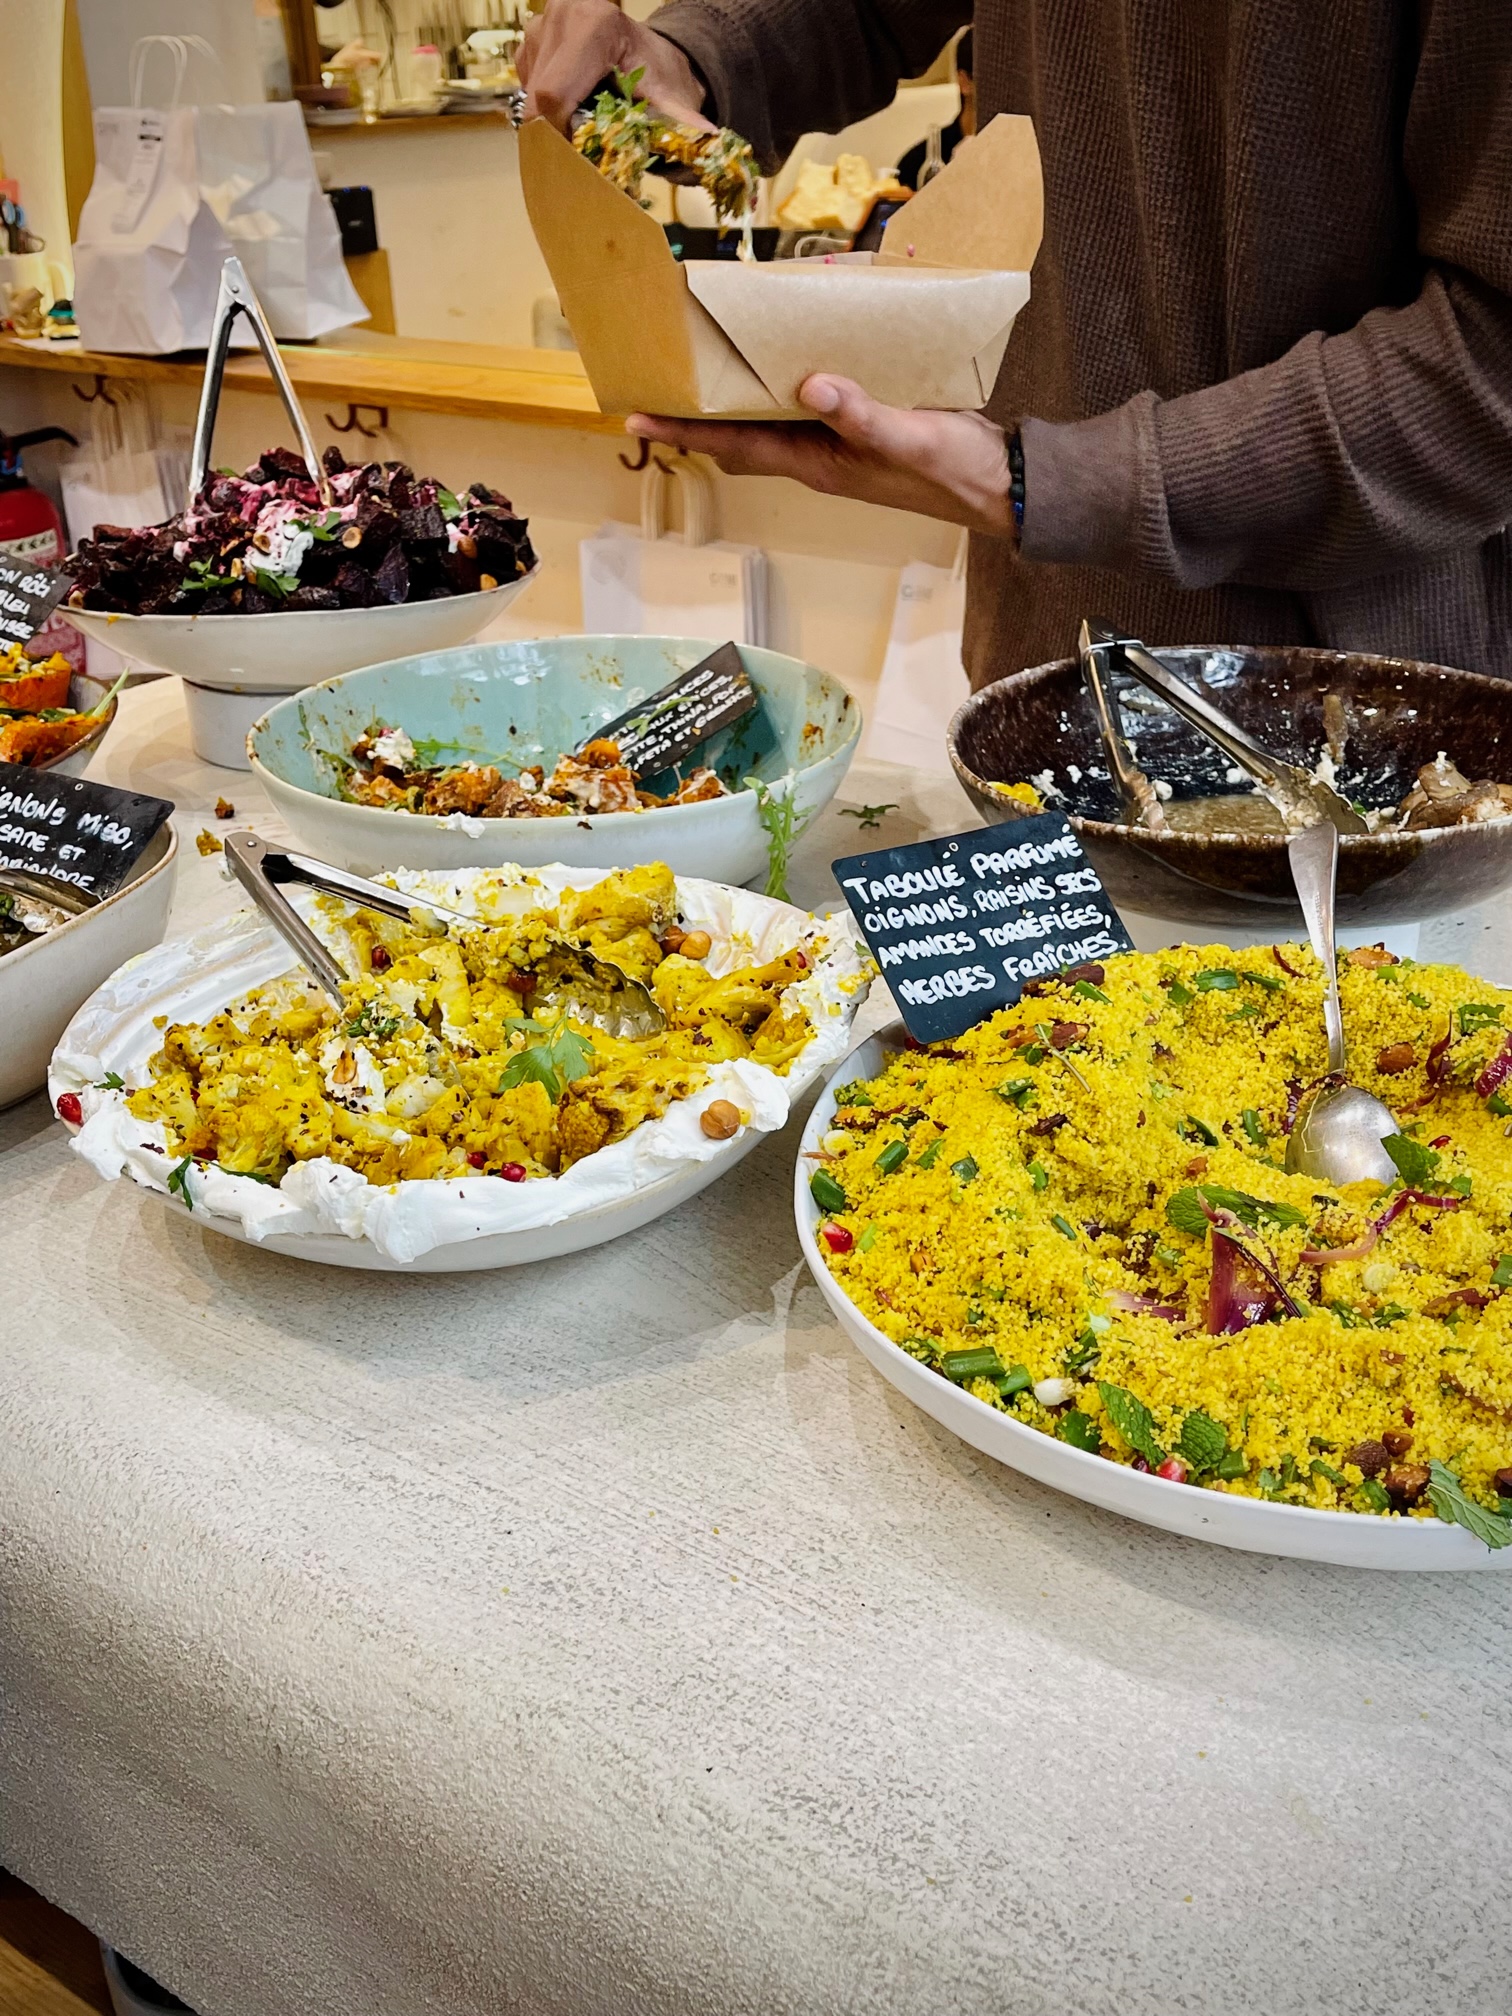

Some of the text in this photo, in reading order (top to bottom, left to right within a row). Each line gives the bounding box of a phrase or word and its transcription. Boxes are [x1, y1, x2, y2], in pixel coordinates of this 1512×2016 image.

[59, 844, 86, 861] ET
[842, 823, 1083, 904] TABOULÉ PARFUMÉ
[876, 930, 976, 969] AMANDES
[898, 965, 996, 1006] HERBES
